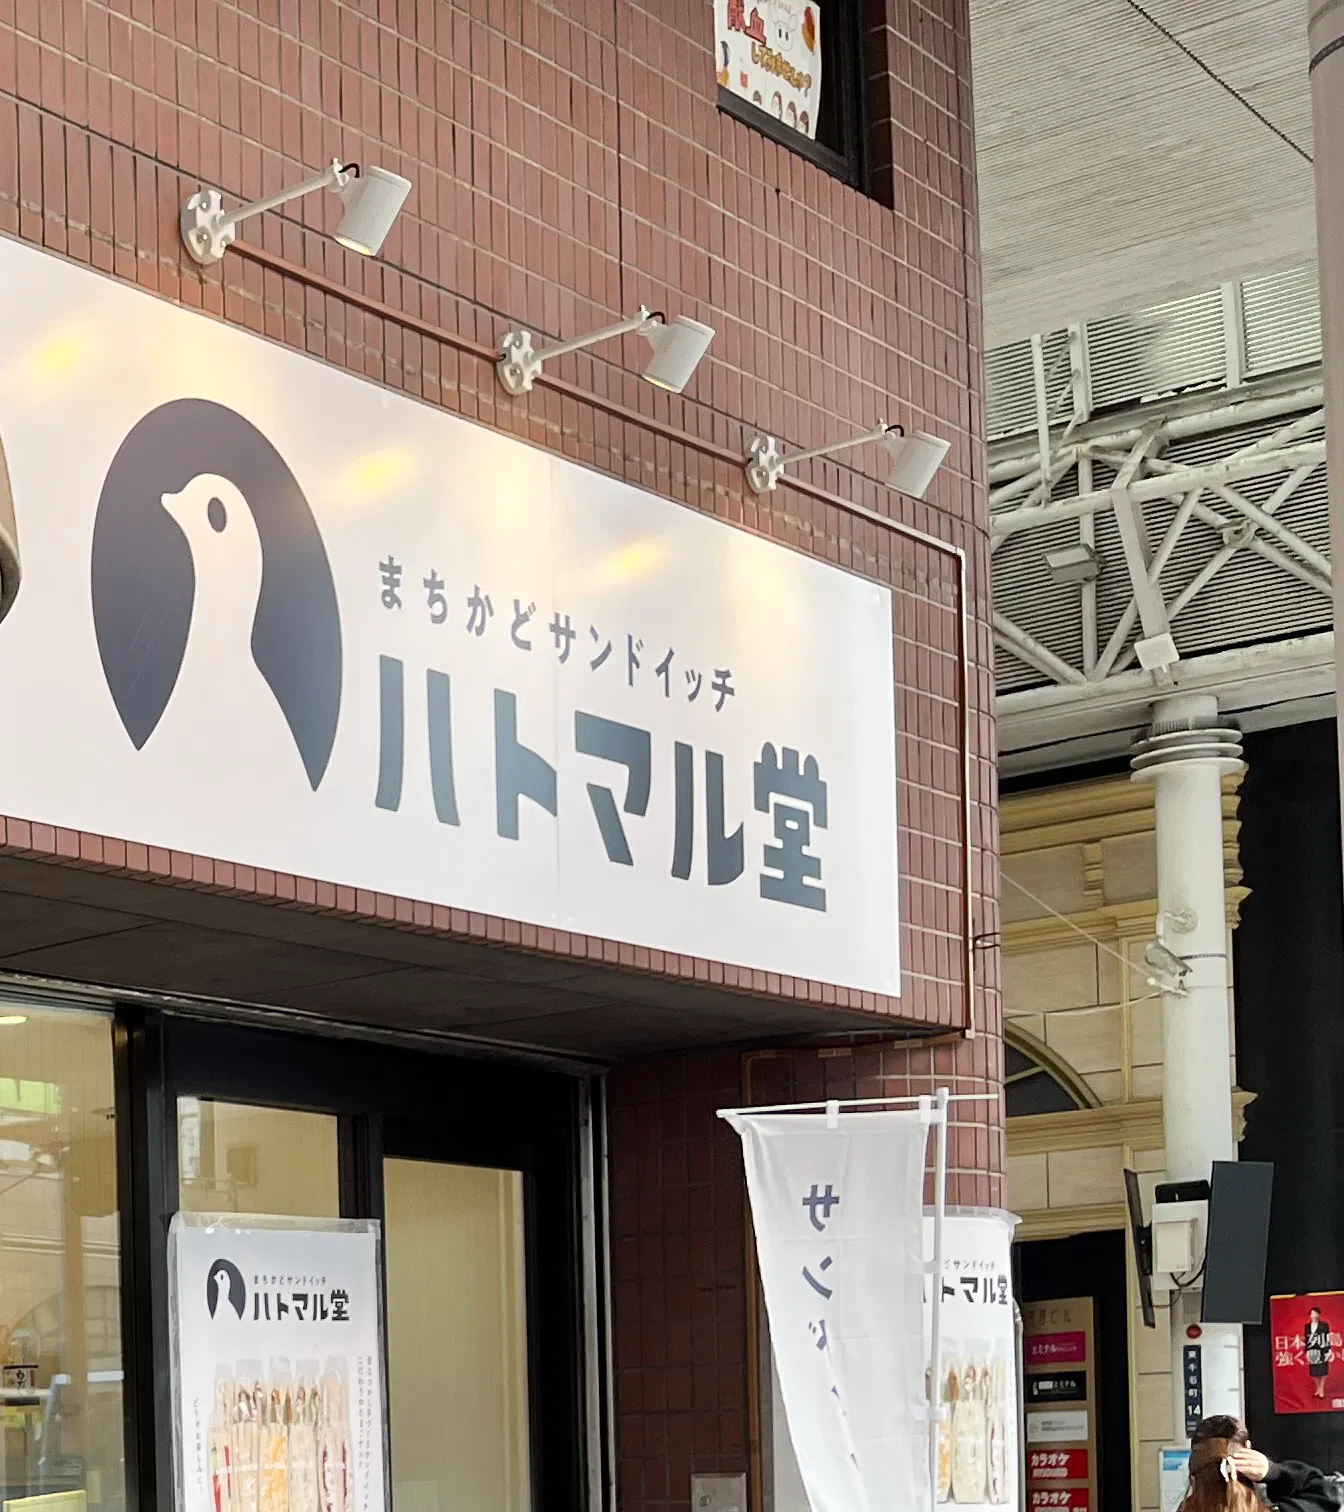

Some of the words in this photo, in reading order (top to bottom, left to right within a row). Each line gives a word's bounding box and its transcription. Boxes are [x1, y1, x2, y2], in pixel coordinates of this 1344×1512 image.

[379, 556, 735, 712] まちかどサンドイッチ
[375, 654, 828, 912] ハトマル堂
[923, 1275, 1007, 1304] トマル堂
[254, 1289, 349, 1321] ハトマル堂
[1275, 1349, 1344, 1367] 強く豊か
[1188, 1405, 1201, 1416] 14
[1031, 1453, 1069, 1466] カラオケ
[1033, 1491, 1071, 1504] カラオケ
